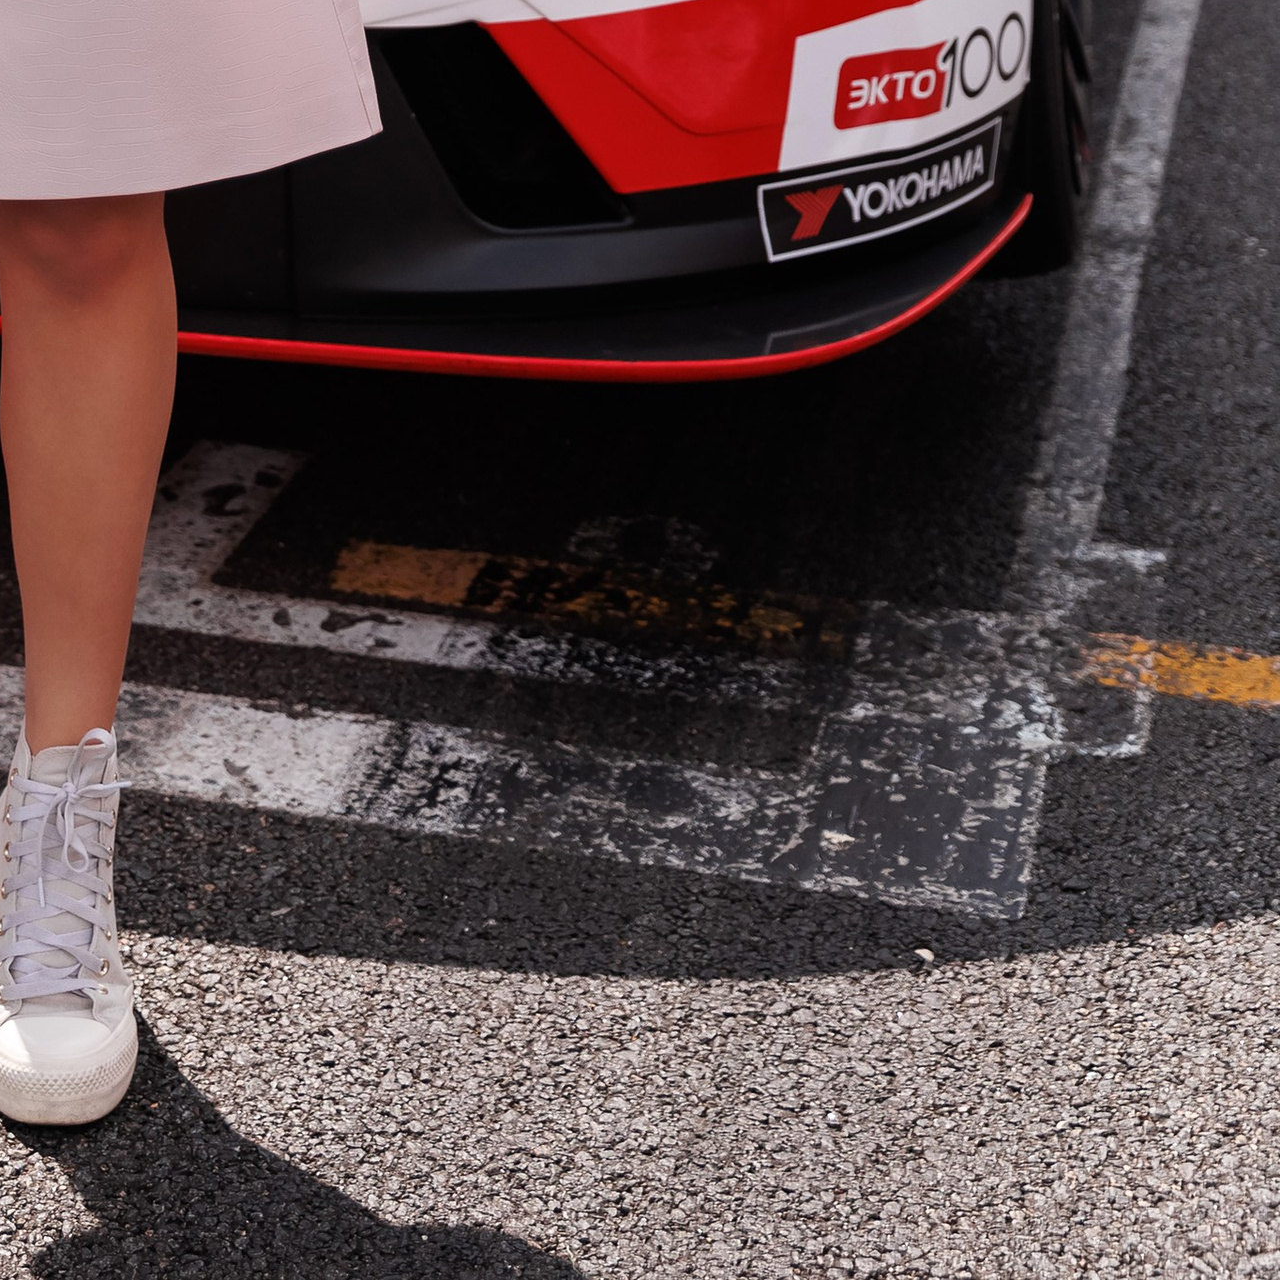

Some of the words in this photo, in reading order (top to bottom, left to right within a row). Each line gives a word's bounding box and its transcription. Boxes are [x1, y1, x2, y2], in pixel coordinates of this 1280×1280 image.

[847, 69, 938, 111] ЭКТО
[942, 12, 1027, 108] 100
[843, 144, 985, 223] YOKOHAMA
